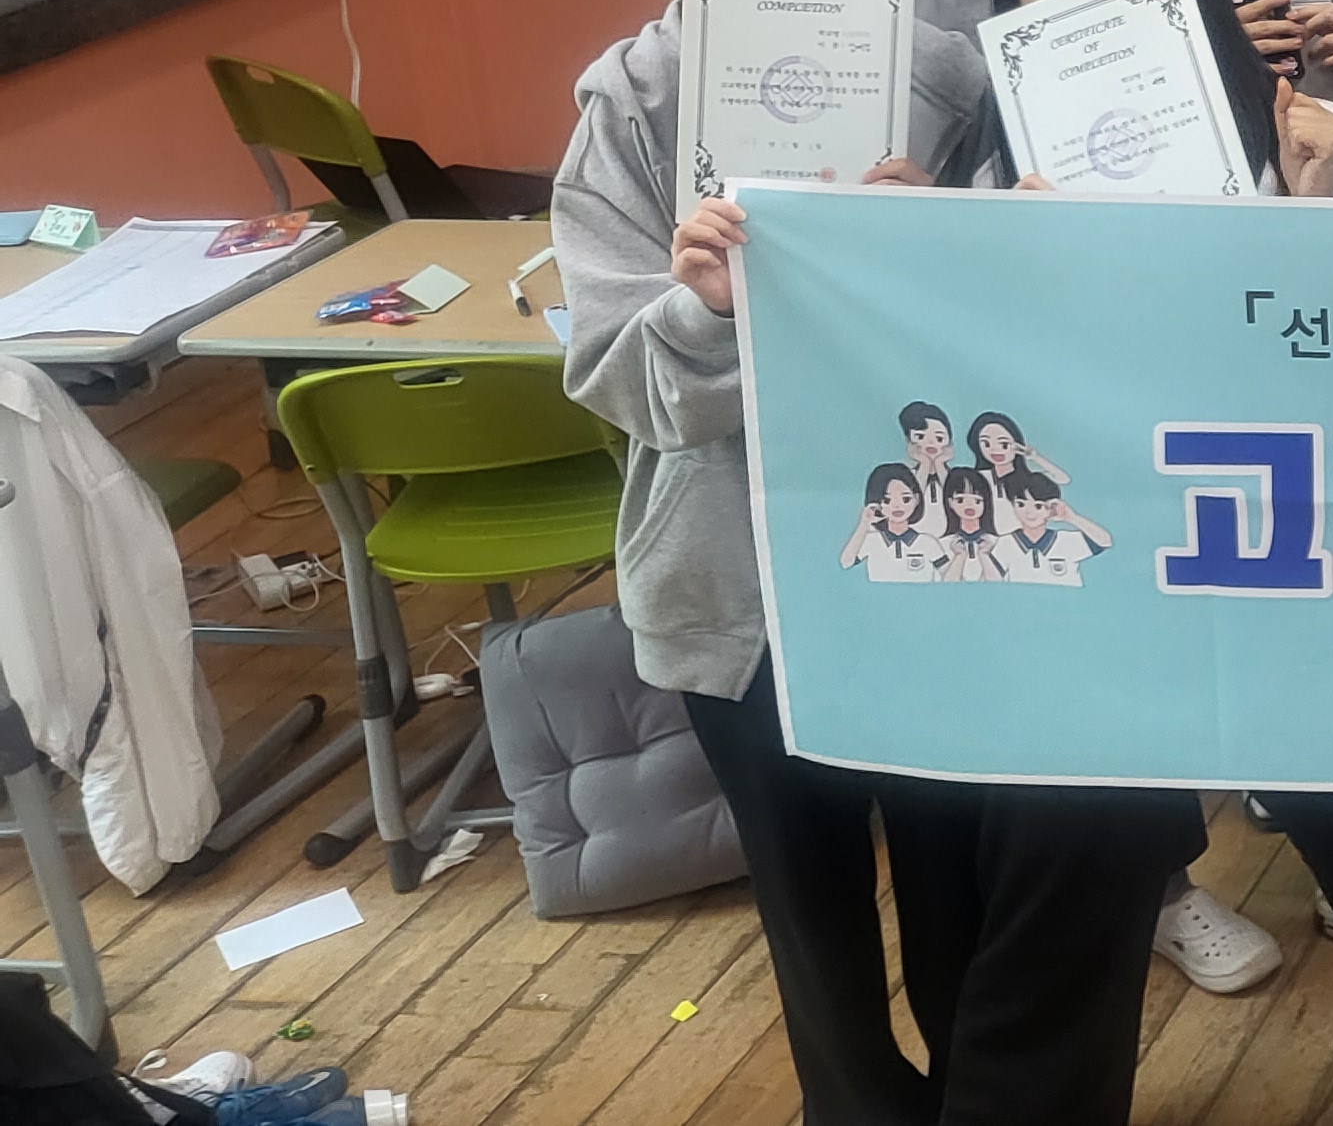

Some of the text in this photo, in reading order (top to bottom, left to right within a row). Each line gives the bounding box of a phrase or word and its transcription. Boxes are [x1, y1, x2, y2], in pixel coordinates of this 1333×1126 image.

[757, 1, 845, 14] COMPLETION
[1050, 15, 1126, 50] CERTIFICATE
[1084, 41, 1100, 54] OF
[1058, 45, 1137, 81] COMPLETION
